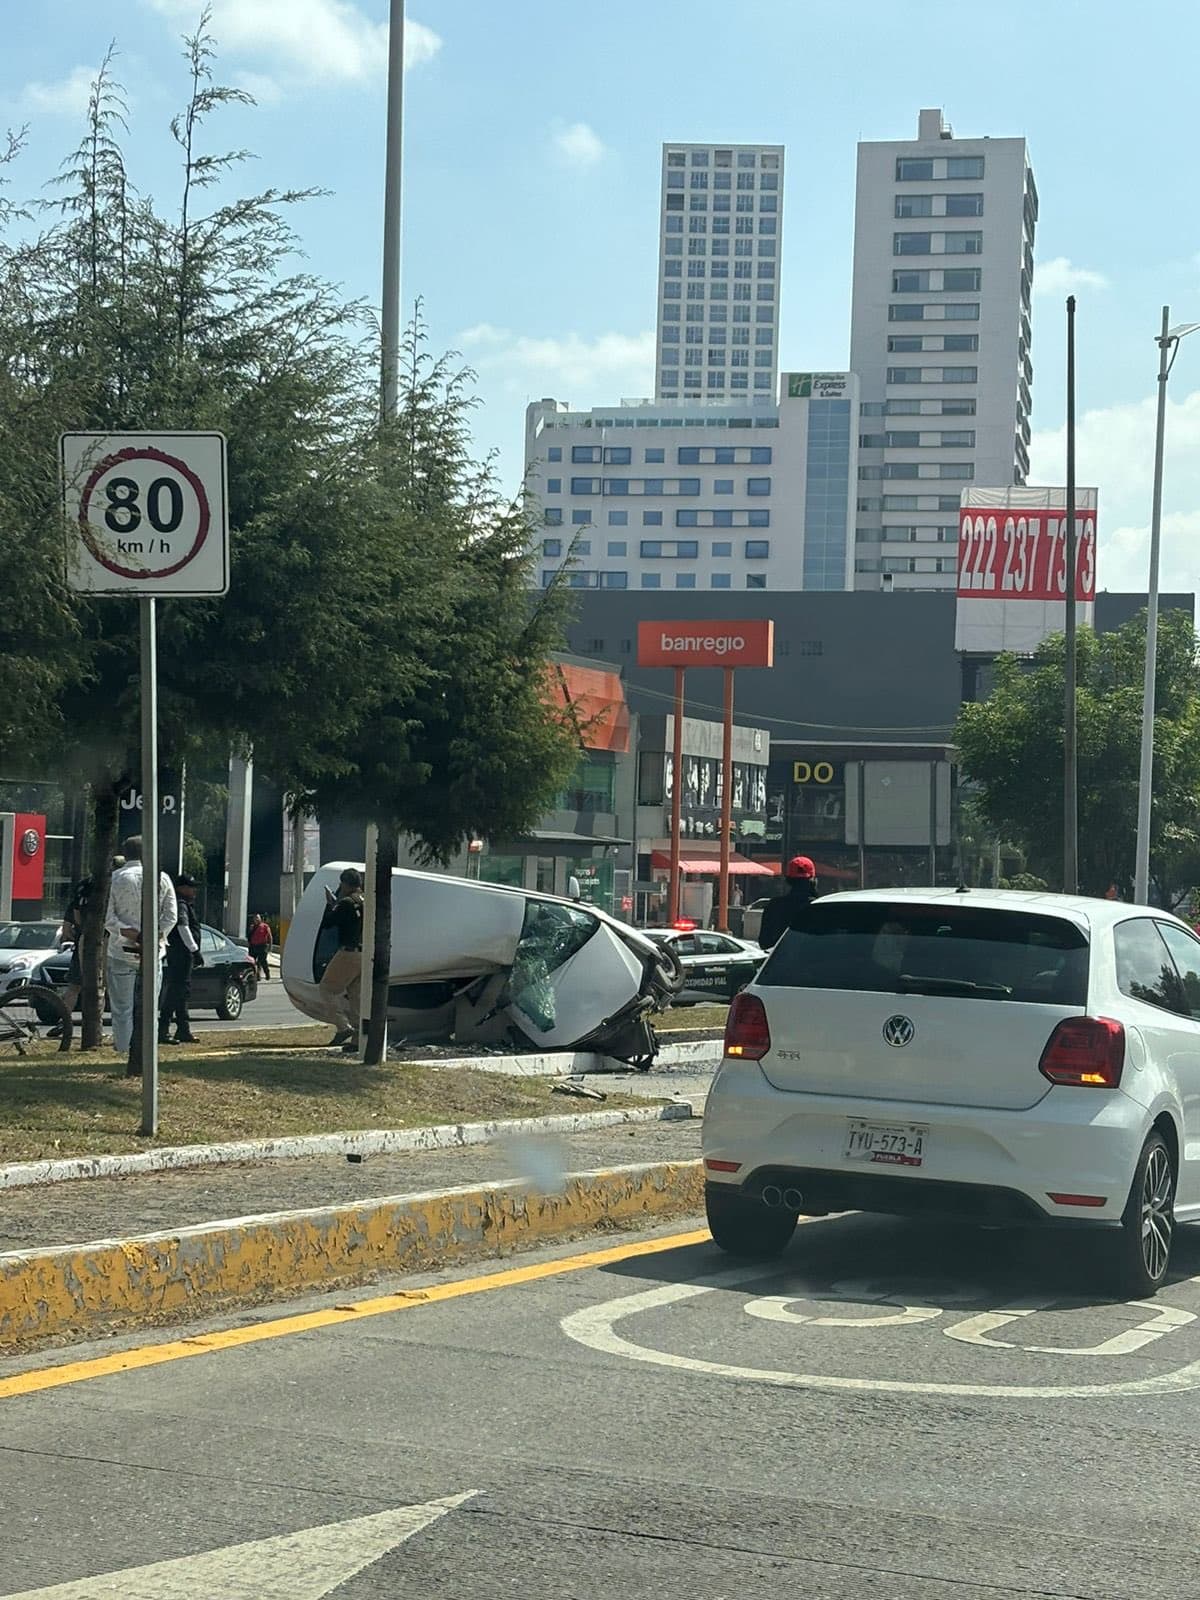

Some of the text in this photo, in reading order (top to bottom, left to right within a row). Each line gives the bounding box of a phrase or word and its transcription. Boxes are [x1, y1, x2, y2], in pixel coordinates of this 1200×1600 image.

[813, 380, 847, 391] Express
[105, 477, 184, 533] 80
[959, 515, 1094, 594] 222 237 7373
[661, 633, 745, 655] banregio
[793, 761, 834, 783] DO
[121, 789, 175, 814] Jep
[848, 1130, 922, 1155] TYU-573-A
